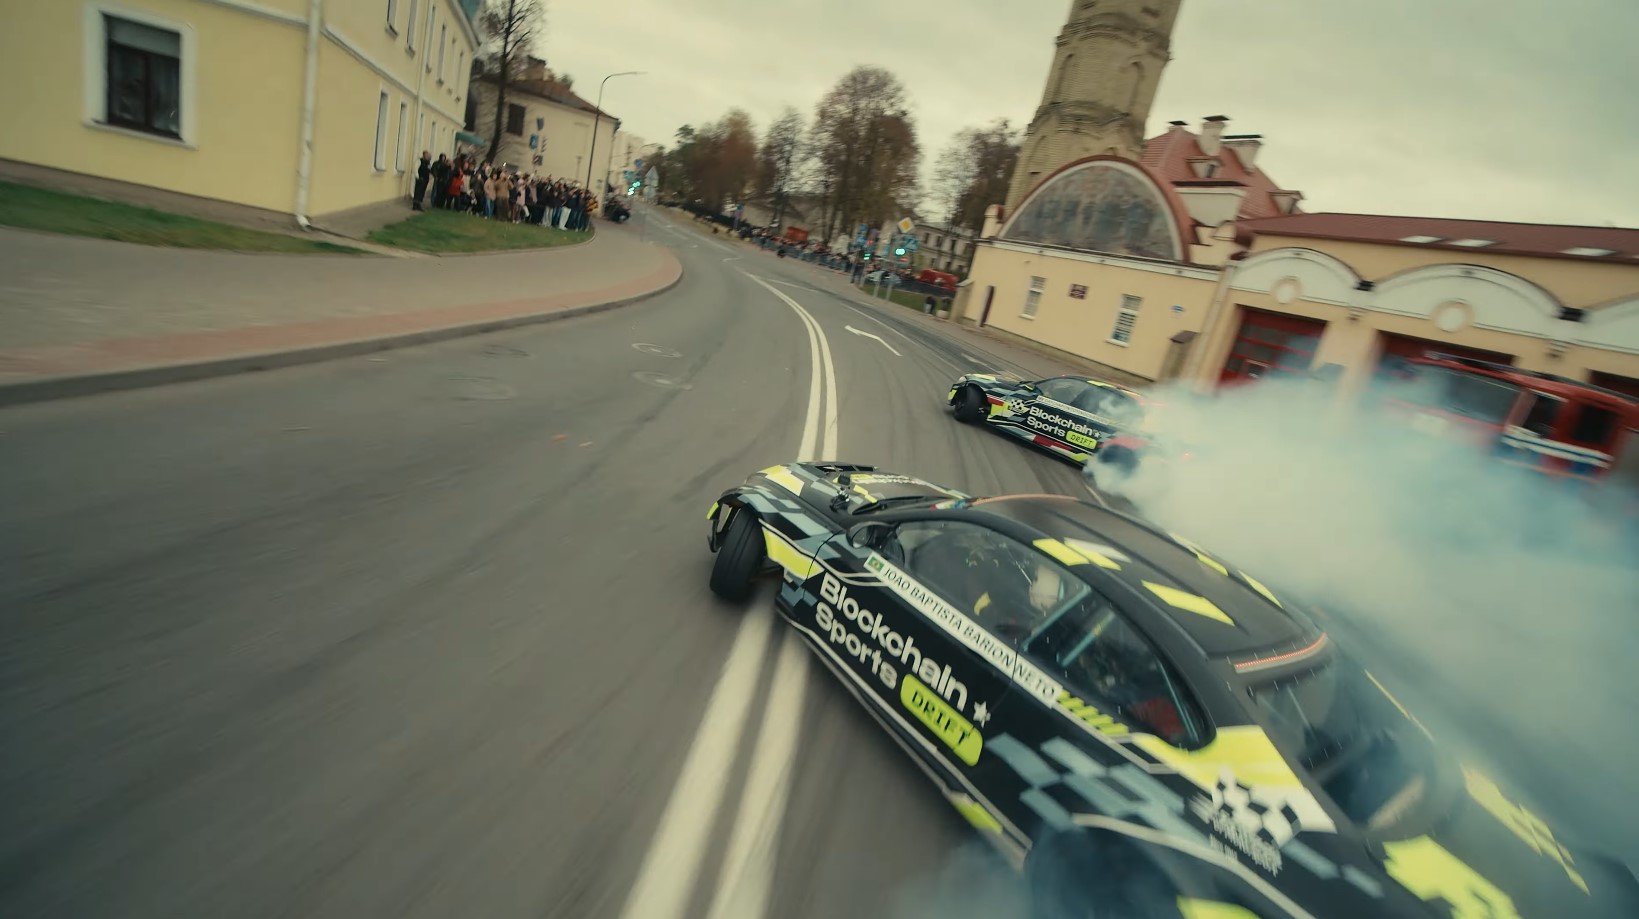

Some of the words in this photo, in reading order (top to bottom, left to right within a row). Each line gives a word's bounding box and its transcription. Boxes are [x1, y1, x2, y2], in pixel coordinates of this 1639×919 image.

[1026, 416, 1066, 437] Sports
[1029, 406, 1093, 436] Blockchain
[1070, 434, 1093, 446] DRIFT
[815, 602, 898, 690] Sports
[819, 573, 968, 712] Blockchain
[910, 587, 963, 630] BAPTISTA
[964, 626, 1014, 667] BARION
[1014, 664, 1056, 697] NETO
[911, 691, 971, 746] DRIFT
